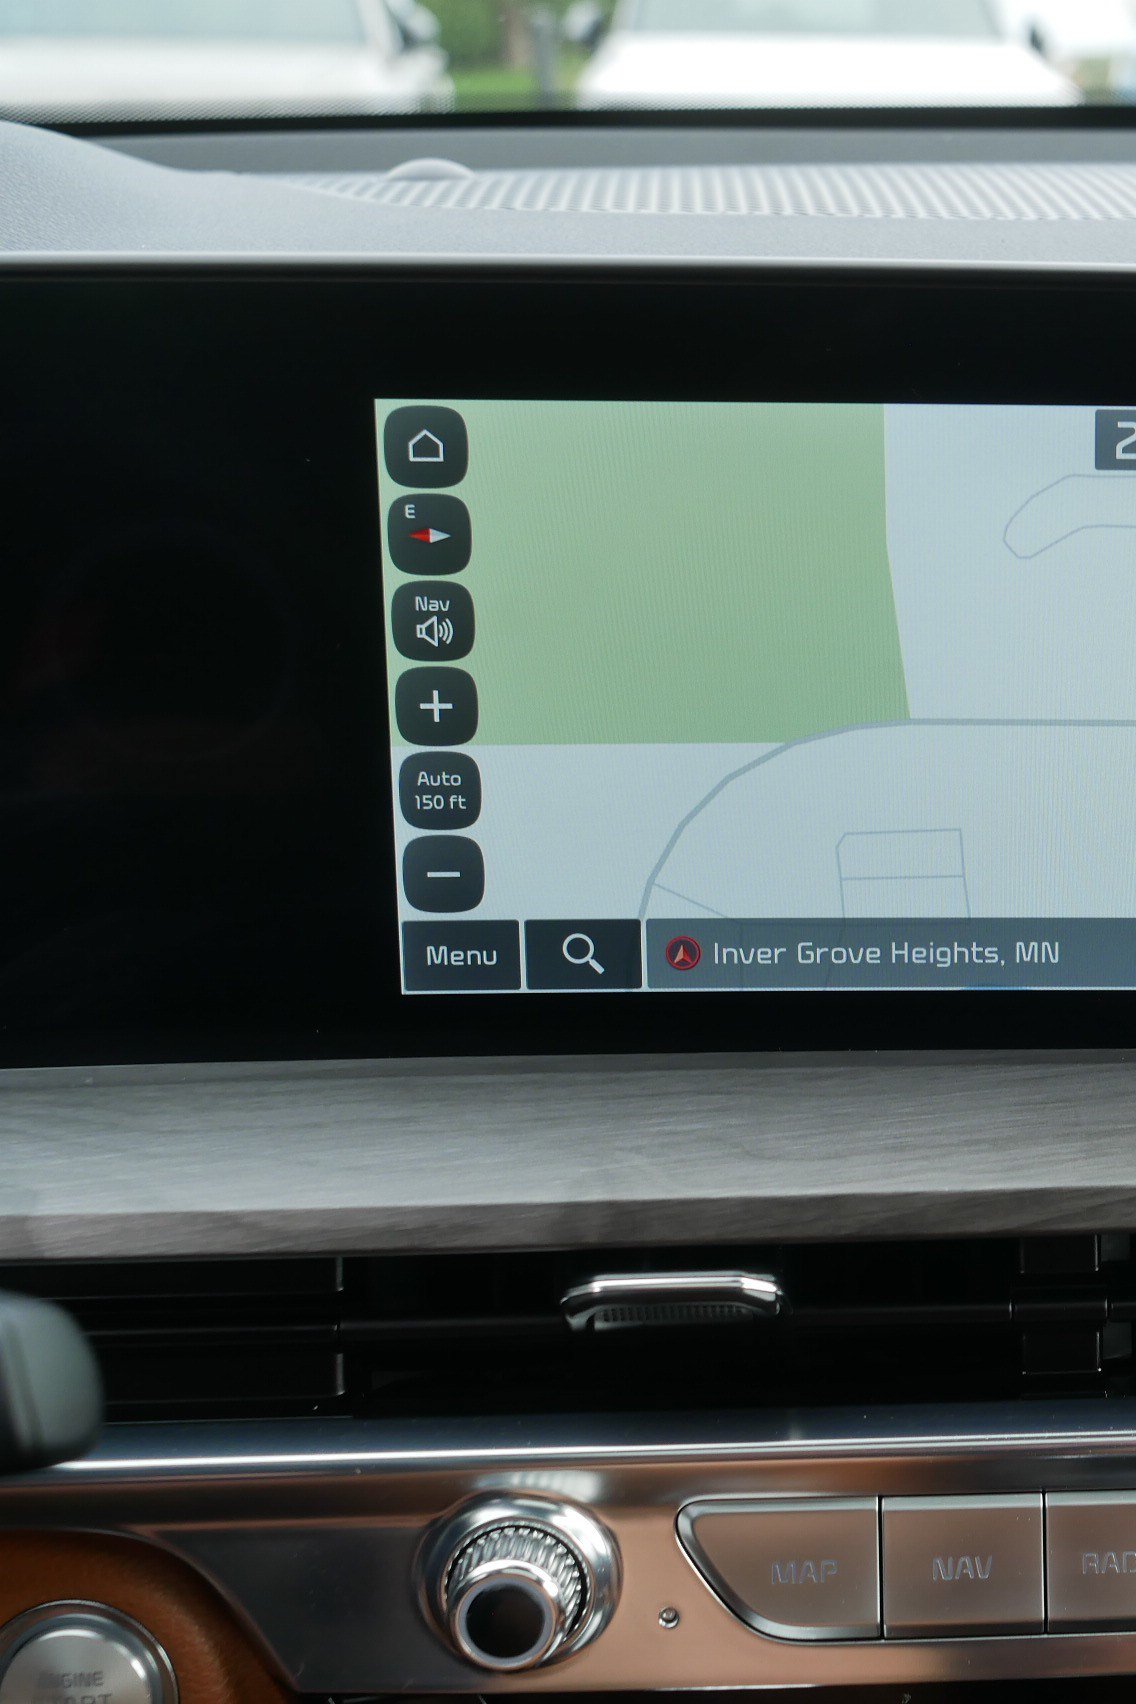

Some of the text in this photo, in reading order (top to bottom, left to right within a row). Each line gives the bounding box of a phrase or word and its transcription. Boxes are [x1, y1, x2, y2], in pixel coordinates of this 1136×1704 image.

[404, 503, 416, 519] E
[415, 595, 450, 612] Nav
[417, 771, 462, 786] Auto
[415, 794, 467, 810] 150 ft
[426, 945, 498, 966] Menu
[713, 941, 1060, 968] Inver Grove Heights, MN
[771, 1559, 838, 1585] MAP
[932, 1555, 993, 1582] NAV
